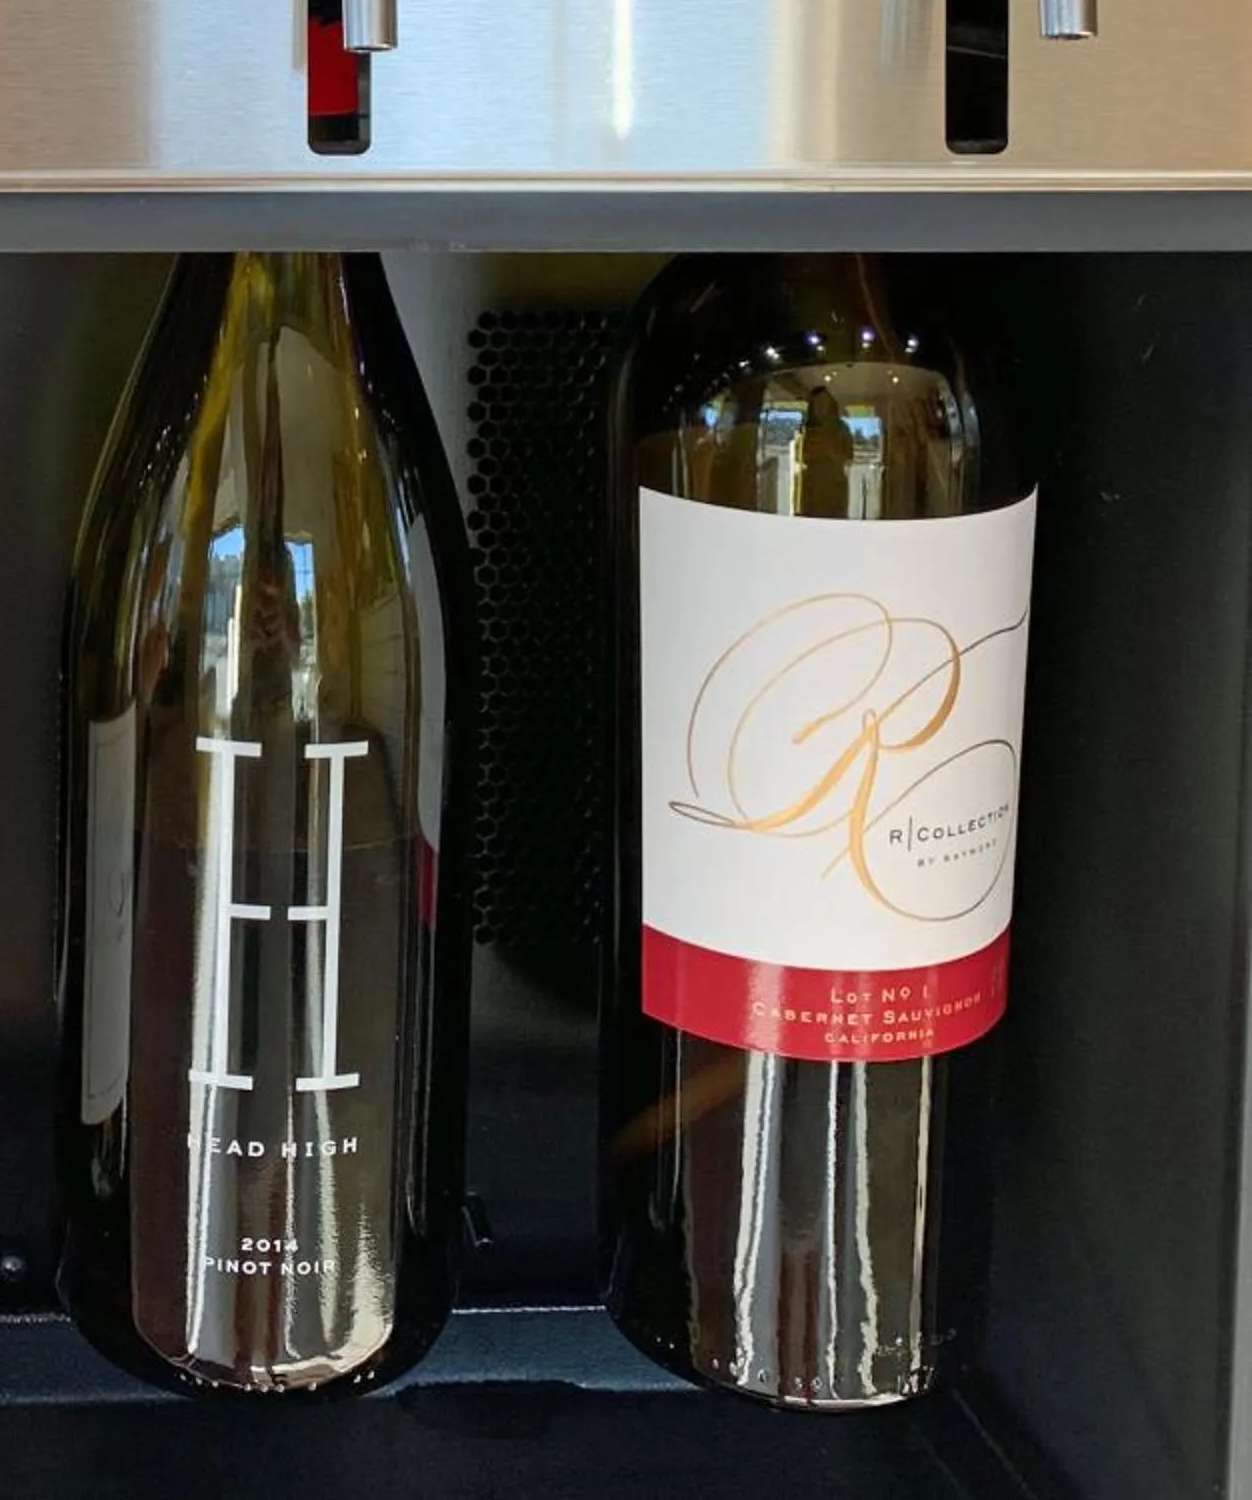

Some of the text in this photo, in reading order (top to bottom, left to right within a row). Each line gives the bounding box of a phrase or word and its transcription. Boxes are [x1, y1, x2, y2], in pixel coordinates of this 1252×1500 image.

[752, 993, 981, 1024] CABERNET SAUVIGNON
[825, 1029, 934, 1043] CALIFORNIA
[281, 1137, 358, 1158] HIGH
[241, 1237, 298, 1252] 2014
[204, 1257, 336, 1275] PINOT NOIR
